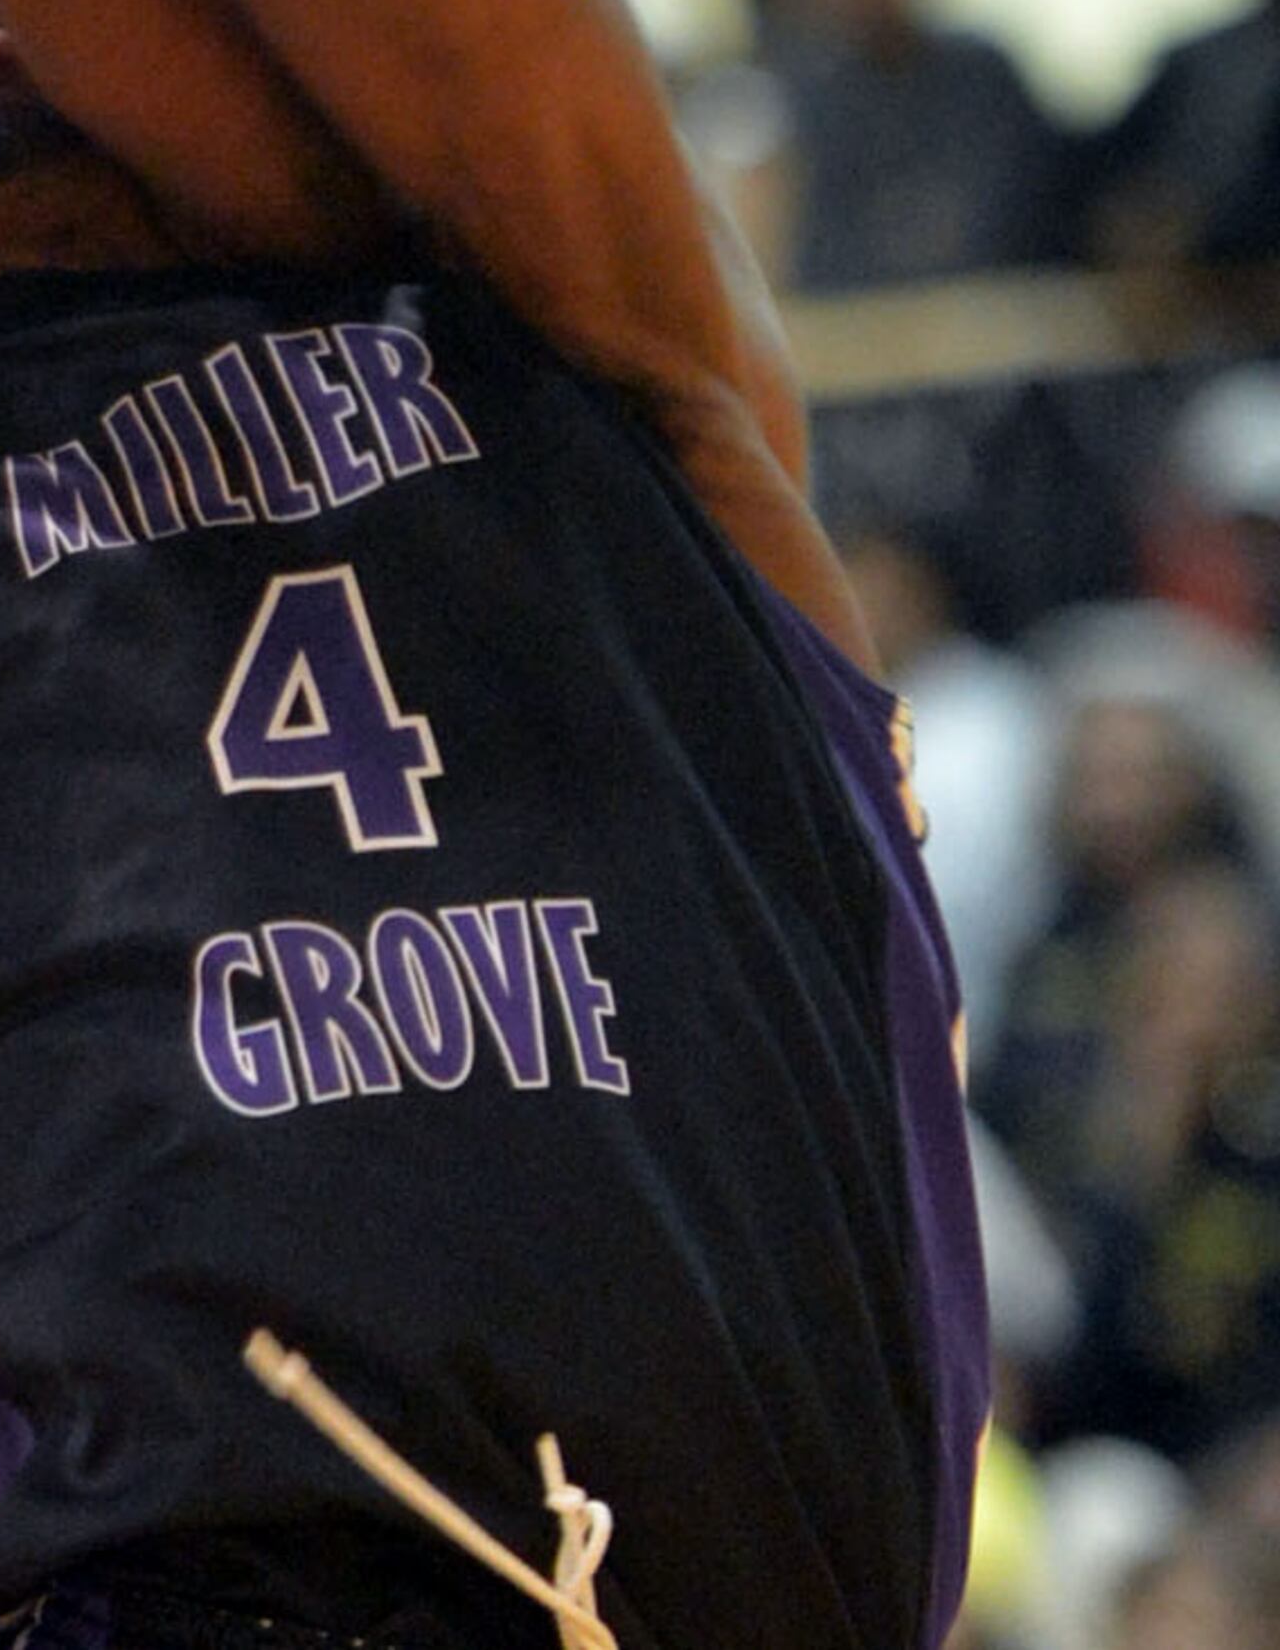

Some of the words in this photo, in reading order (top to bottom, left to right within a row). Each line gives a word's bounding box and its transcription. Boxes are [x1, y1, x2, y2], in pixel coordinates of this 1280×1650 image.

[6, 325, 480, 578] MILLER
[207, 565, 443, 852] 4
[193, 900, 630, 1116] GROVE
